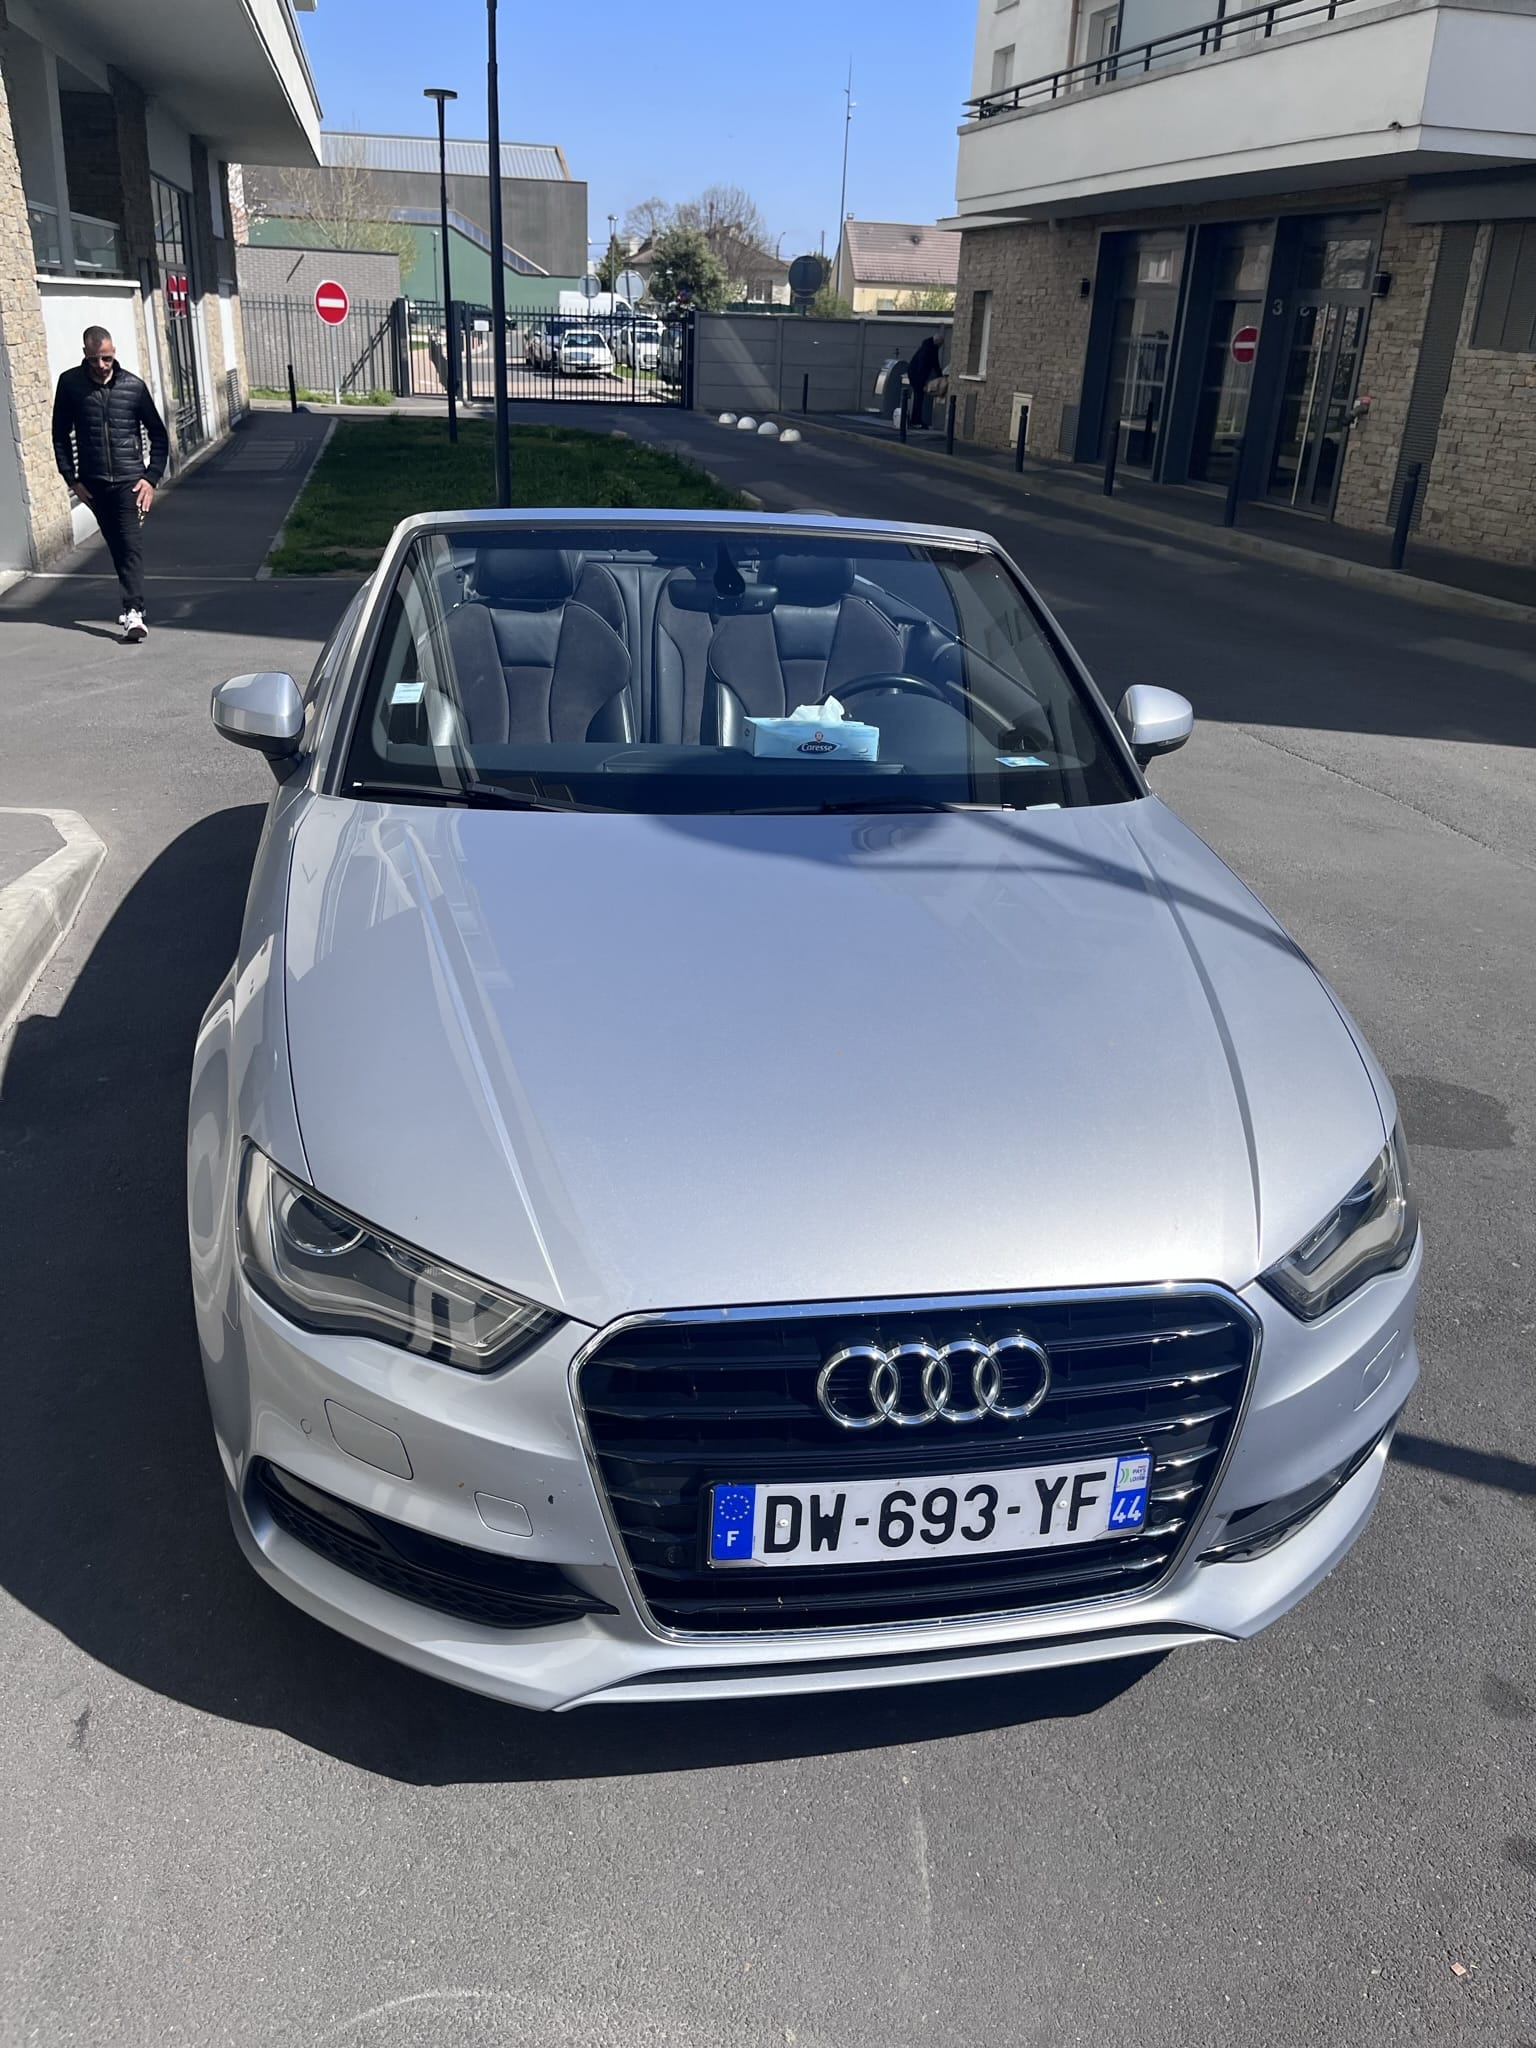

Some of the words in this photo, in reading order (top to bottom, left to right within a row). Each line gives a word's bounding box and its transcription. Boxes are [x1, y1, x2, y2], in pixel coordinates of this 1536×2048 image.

[1272, 298, 1283, 315] 3
[801, 743, 833, 752] Caresse
[763, 1471, 1107, 1553] DW-693-YF
[1112, 1496, 1141, 1523] 44
[726, 1530, 740, 1547] F
